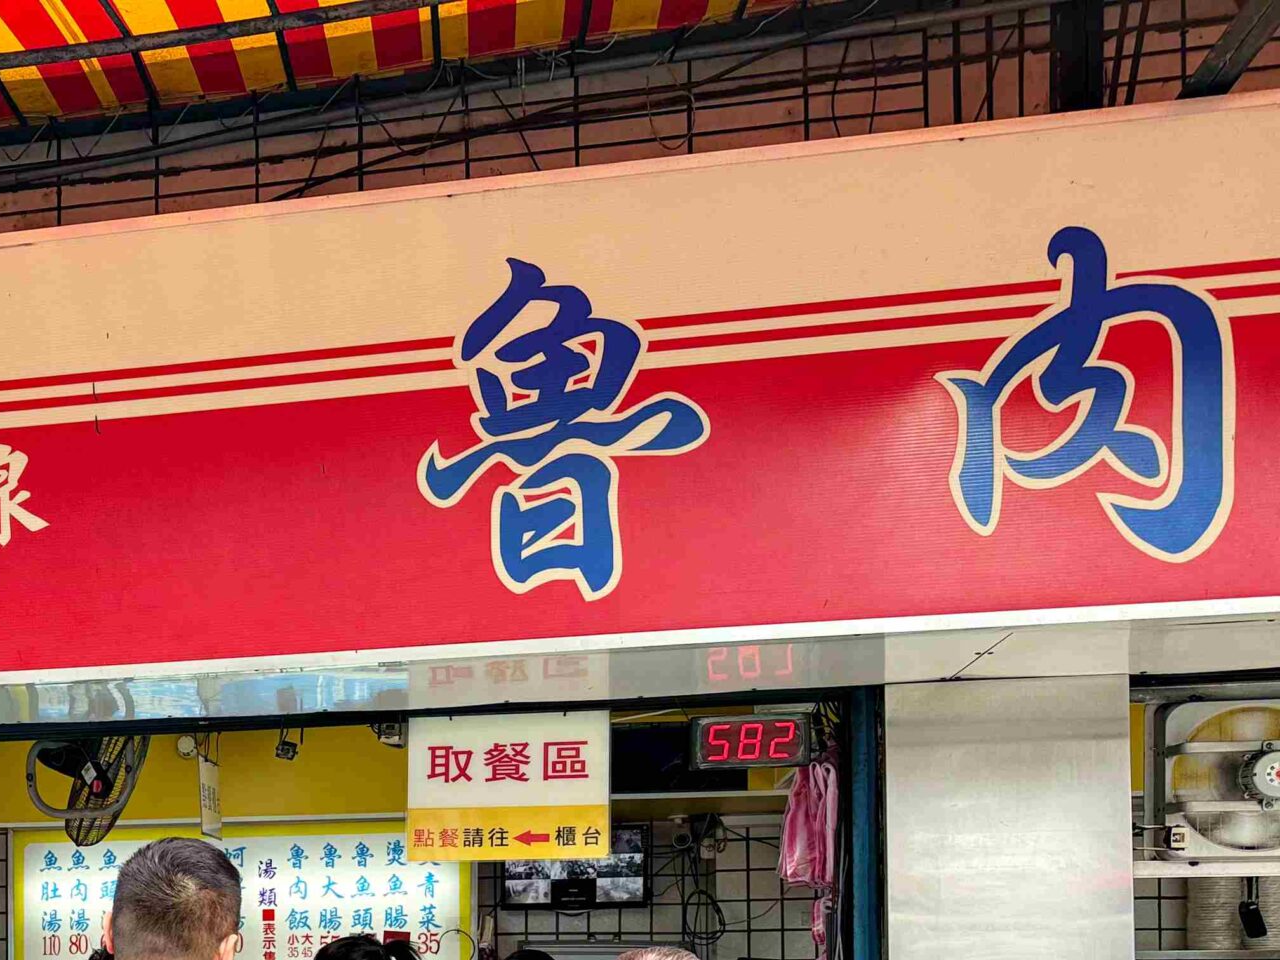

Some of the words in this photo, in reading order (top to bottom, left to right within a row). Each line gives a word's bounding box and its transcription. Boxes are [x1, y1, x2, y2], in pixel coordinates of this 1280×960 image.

[427, 740, 589, 783] 取餐區
[707, 722, 796, 761] 582
[413, 827, 510, 848] 點餐請往
[554, 826, 602, 847] 櫃台
[40, 849, 62, 932] 魚肚湯
[68, 849, 90, 932] 魚肉湯
[258, 859, 278, 907] 湯類
[285, 843, 312, 931] 魯肉飯
[319, 842, 344, 931] 魯大腸
[350, 841, 376, 930] 魯魚頭
[42, 935, 61, 956] 110
[69, 934, 88, 955] 80
[287, 934, 299, 946] 小
[301, 933, 313, 946] 大
[287, 947, 299, 958] 35
[301, 947, 313, 958] 45
[417, 933, 440, 955] 35
